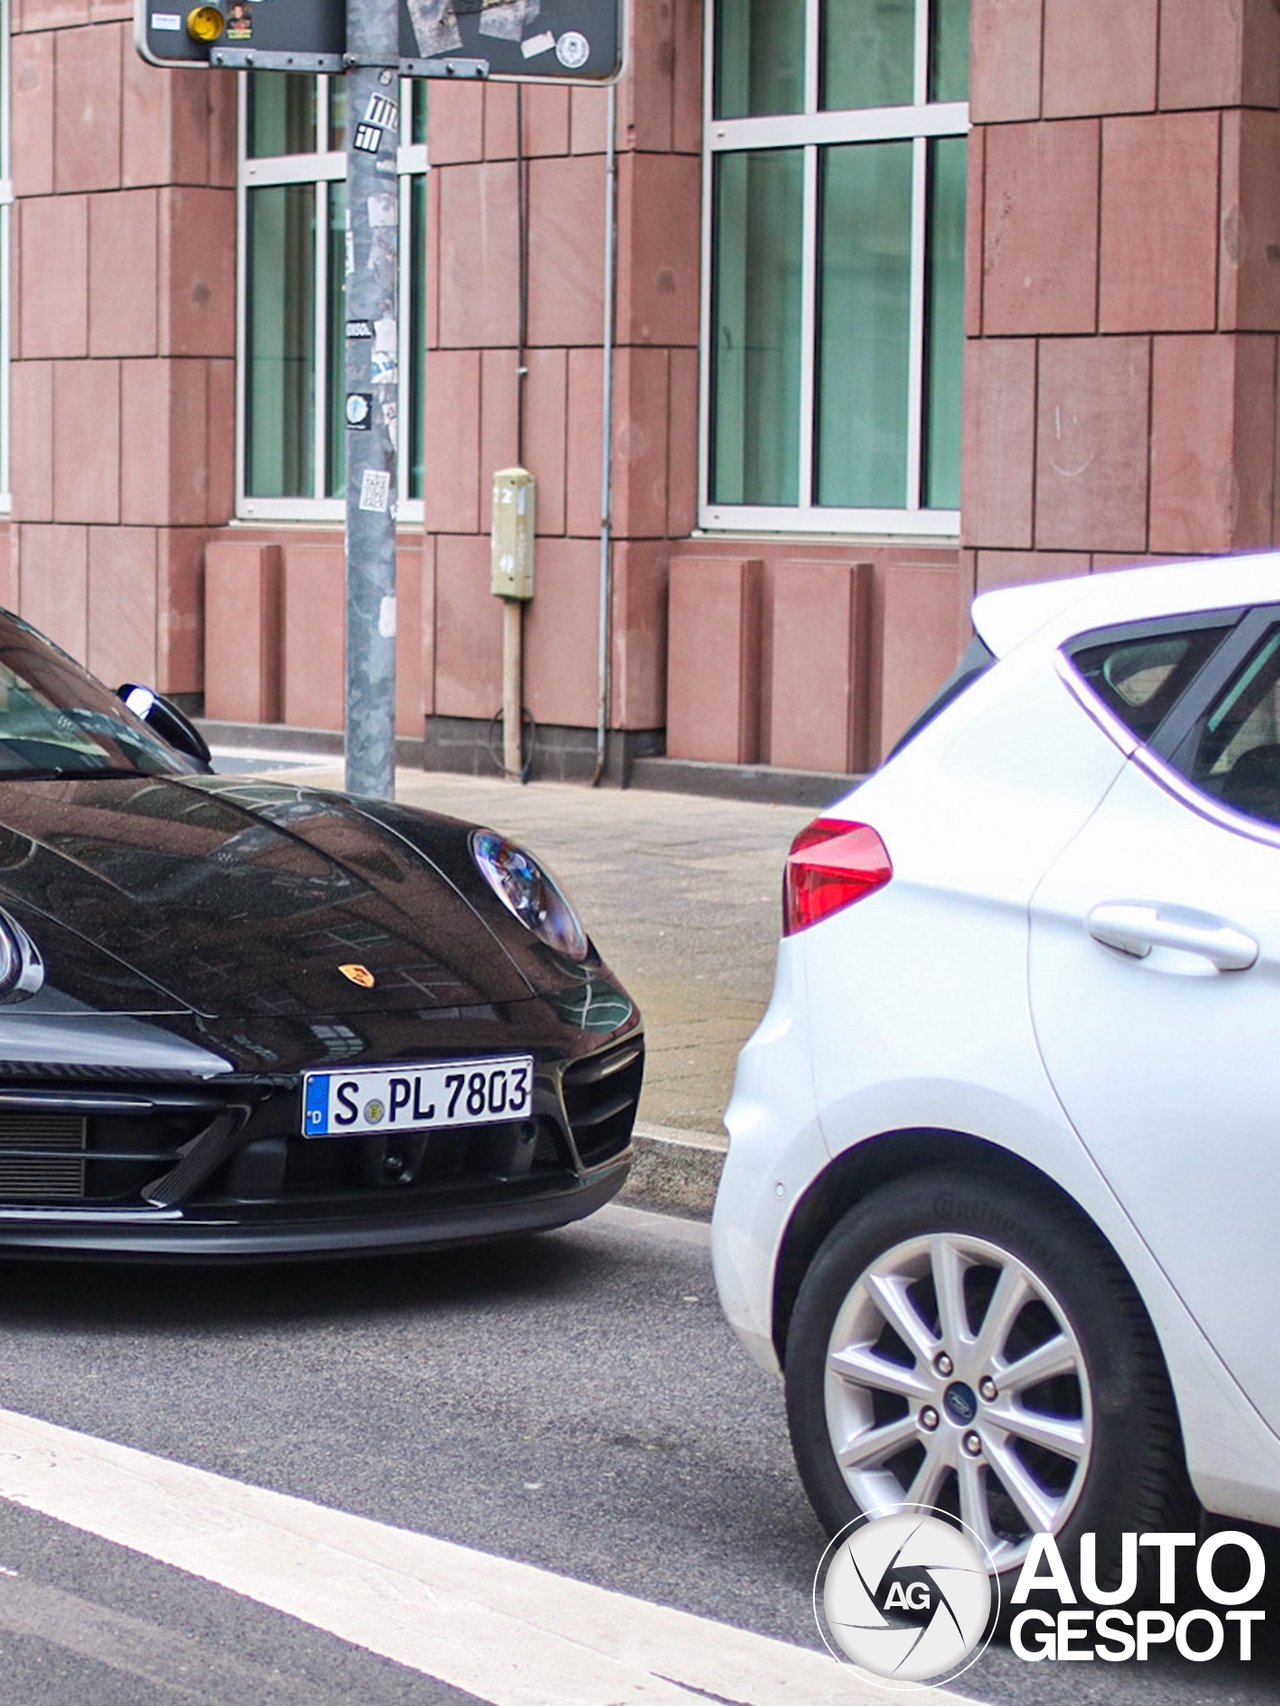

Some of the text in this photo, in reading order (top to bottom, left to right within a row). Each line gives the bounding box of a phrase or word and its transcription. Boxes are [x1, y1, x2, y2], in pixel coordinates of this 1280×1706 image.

[334, 1068, 528, 1126] S PL 7803
[311, 1110, 322, 1124] D
